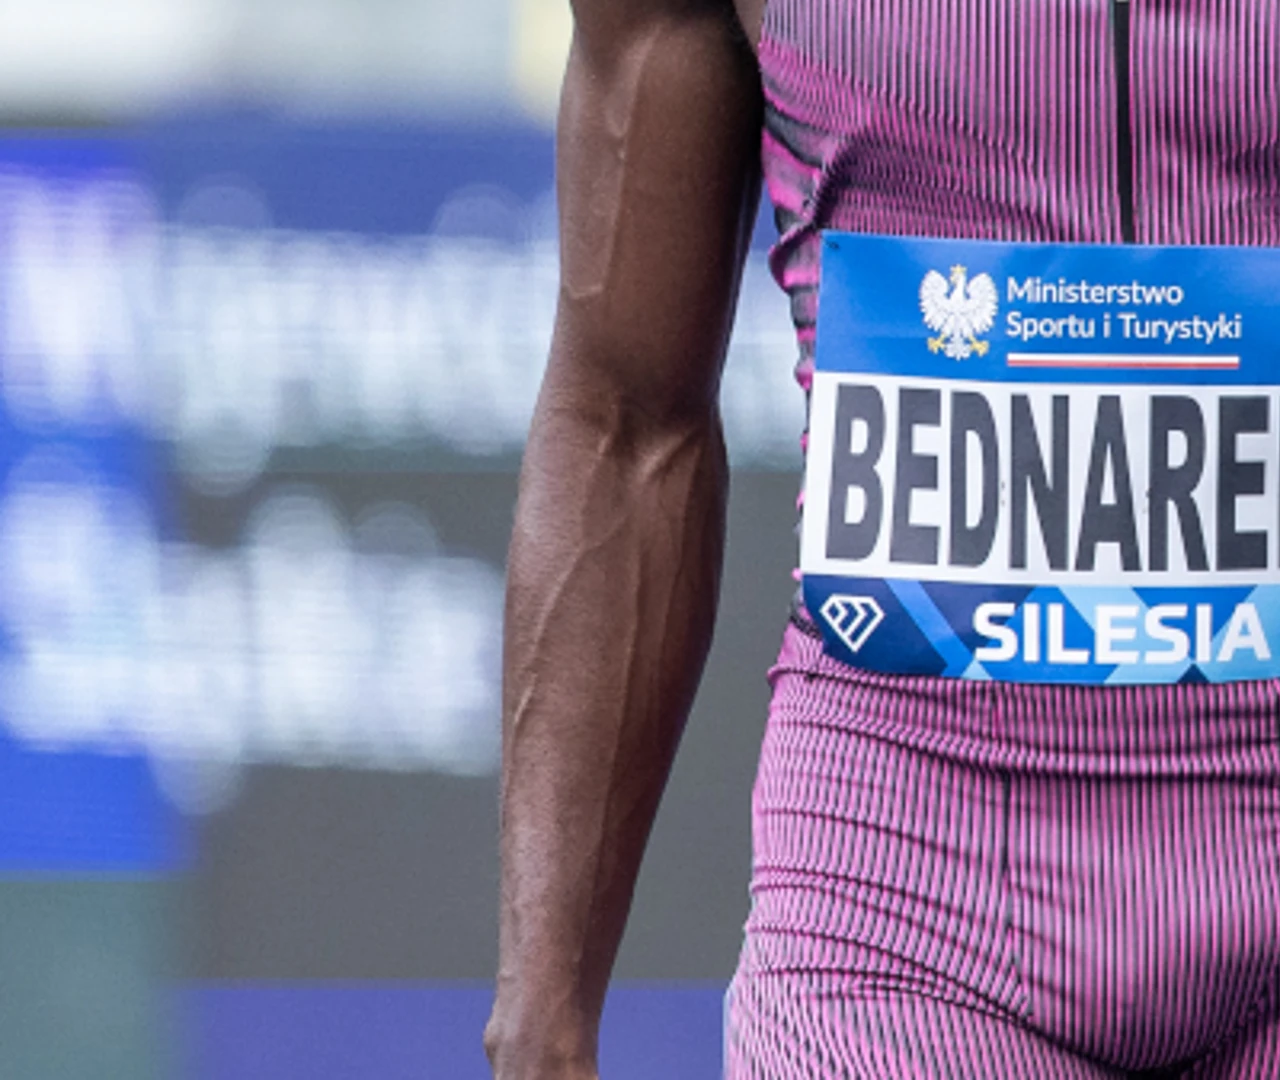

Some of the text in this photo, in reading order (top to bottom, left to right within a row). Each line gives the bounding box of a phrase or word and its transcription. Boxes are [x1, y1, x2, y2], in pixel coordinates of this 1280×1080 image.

[1007, 277, 1183, 305] Ministerstwo
[1007, 311, 1242, 343] Sportu i Turystyki
[972, 602, 1271, 665] SILESIA
